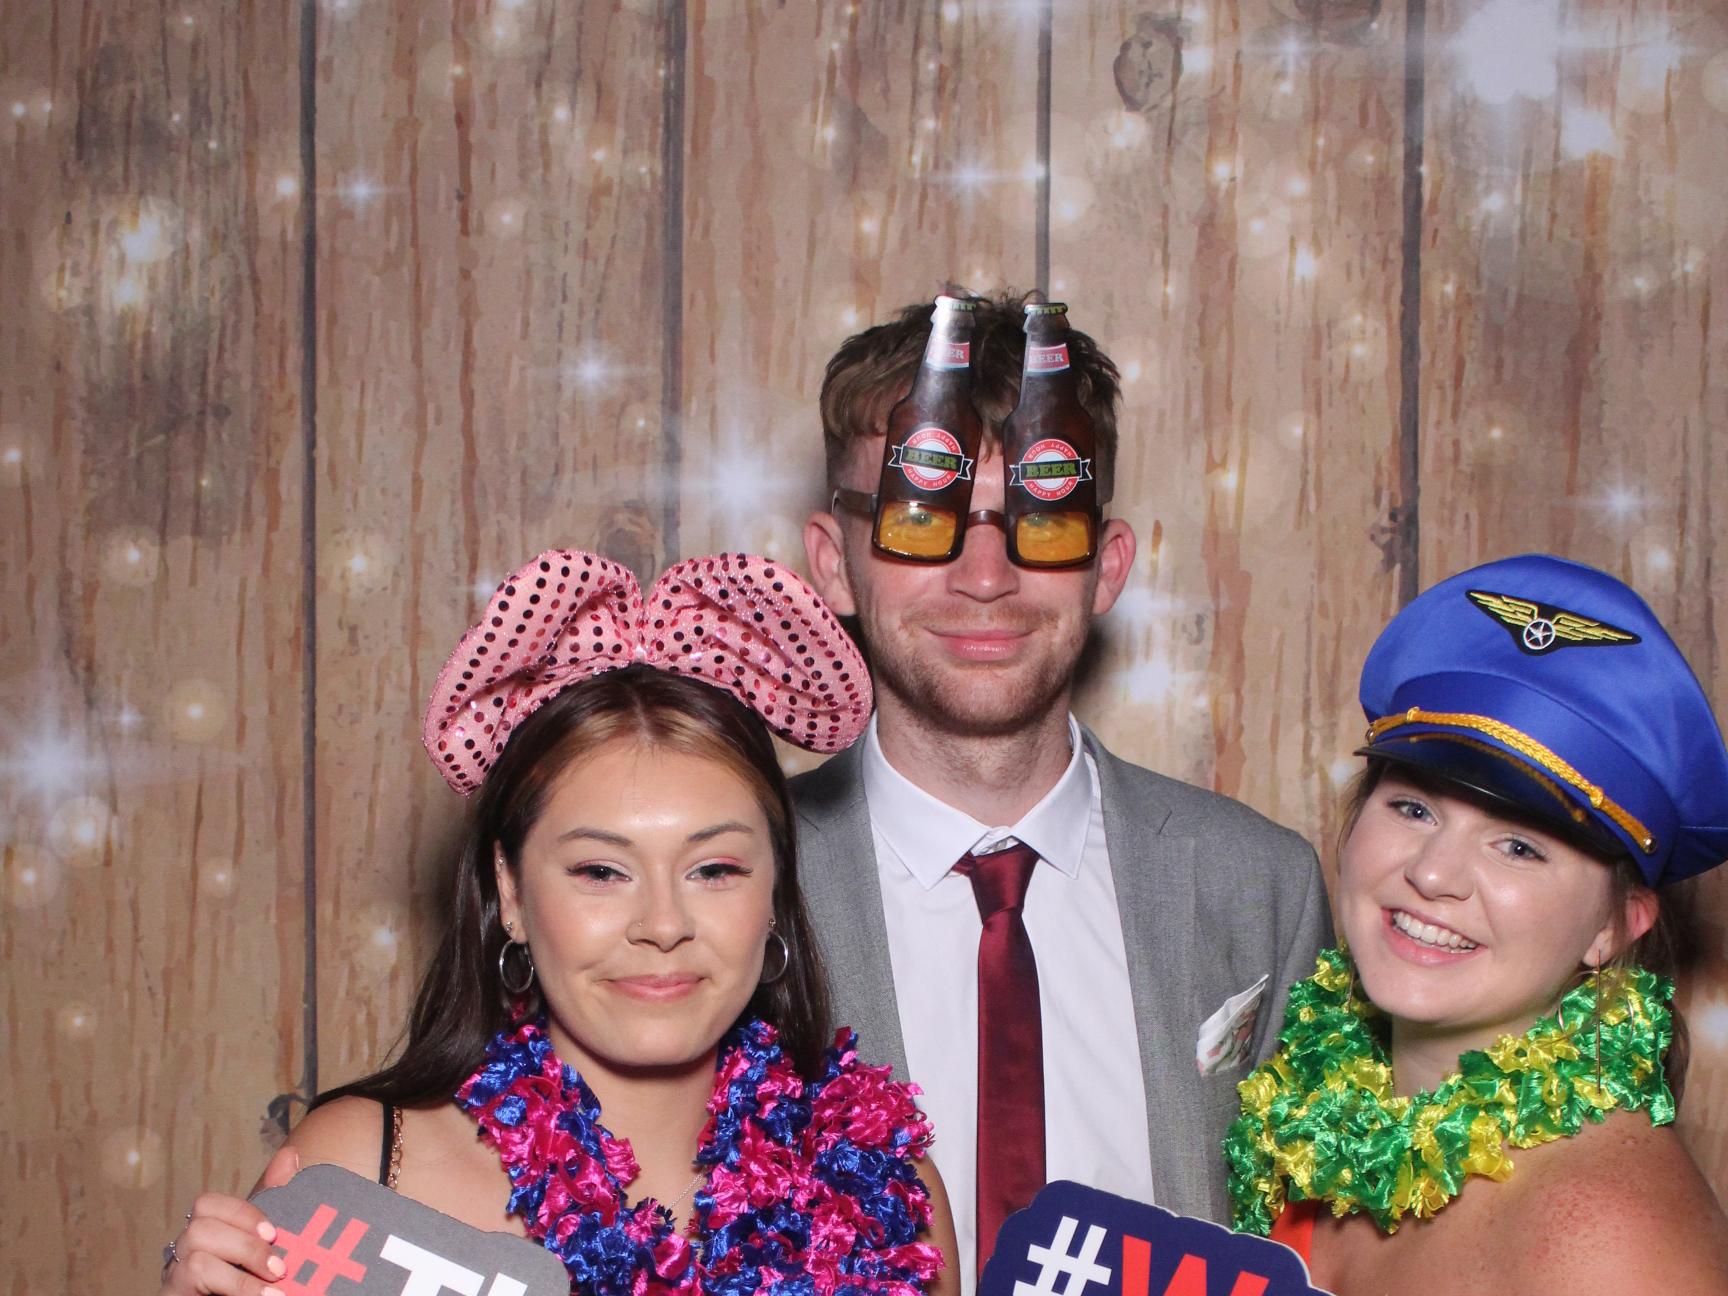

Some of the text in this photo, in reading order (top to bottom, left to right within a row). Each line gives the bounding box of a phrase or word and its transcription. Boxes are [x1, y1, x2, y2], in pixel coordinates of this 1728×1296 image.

[904, 449, 957, 470] BEER
[906, 467, 952, 487] HAPPY HOUR
[1025, 463, 1077, 478] BEER
[1029, 480, 1074, 498] HAPPY HOUR
